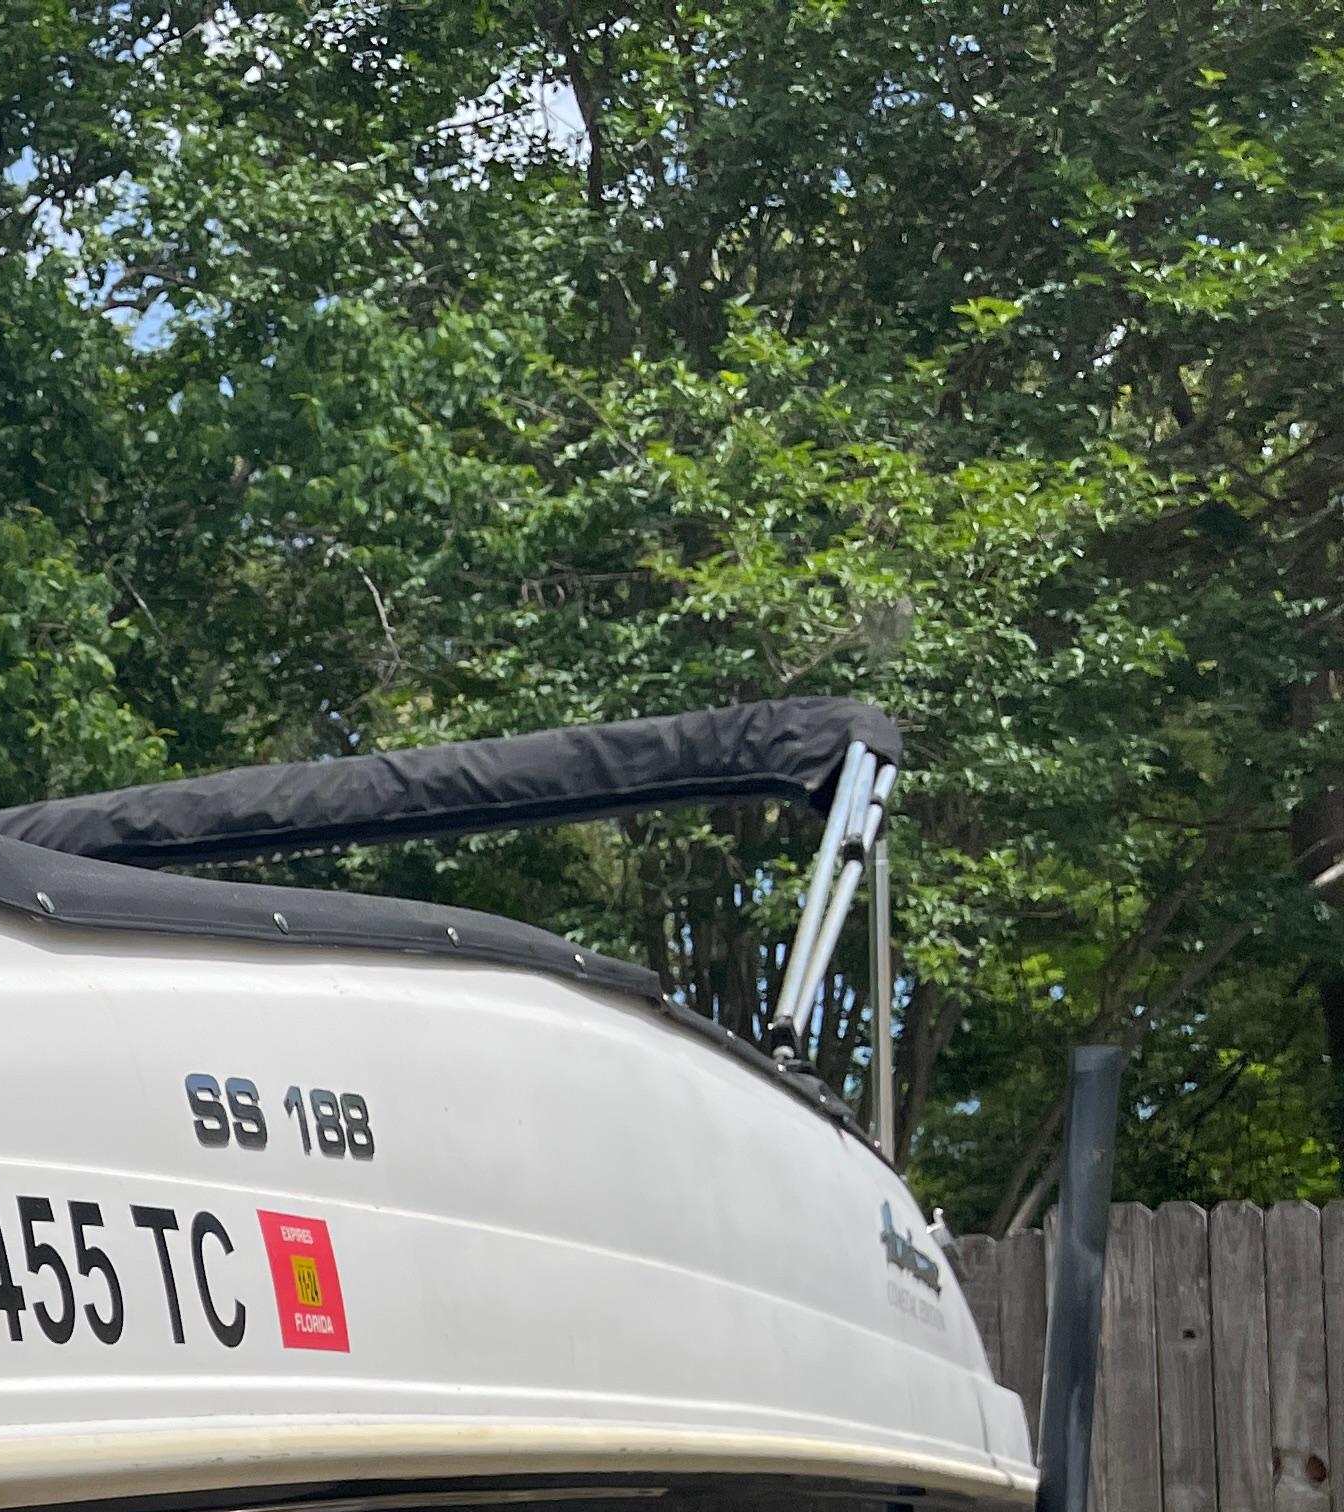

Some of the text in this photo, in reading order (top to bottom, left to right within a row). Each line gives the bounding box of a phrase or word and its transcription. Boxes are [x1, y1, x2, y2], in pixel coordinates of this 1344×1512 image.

[185, 1072, 375, 1162] SS 188
[279, 1225, 314, 1245] EXPIRES
[130, 1203, 247, 1348] TC
[294, 1312, 335, 1334] FLORIDA
